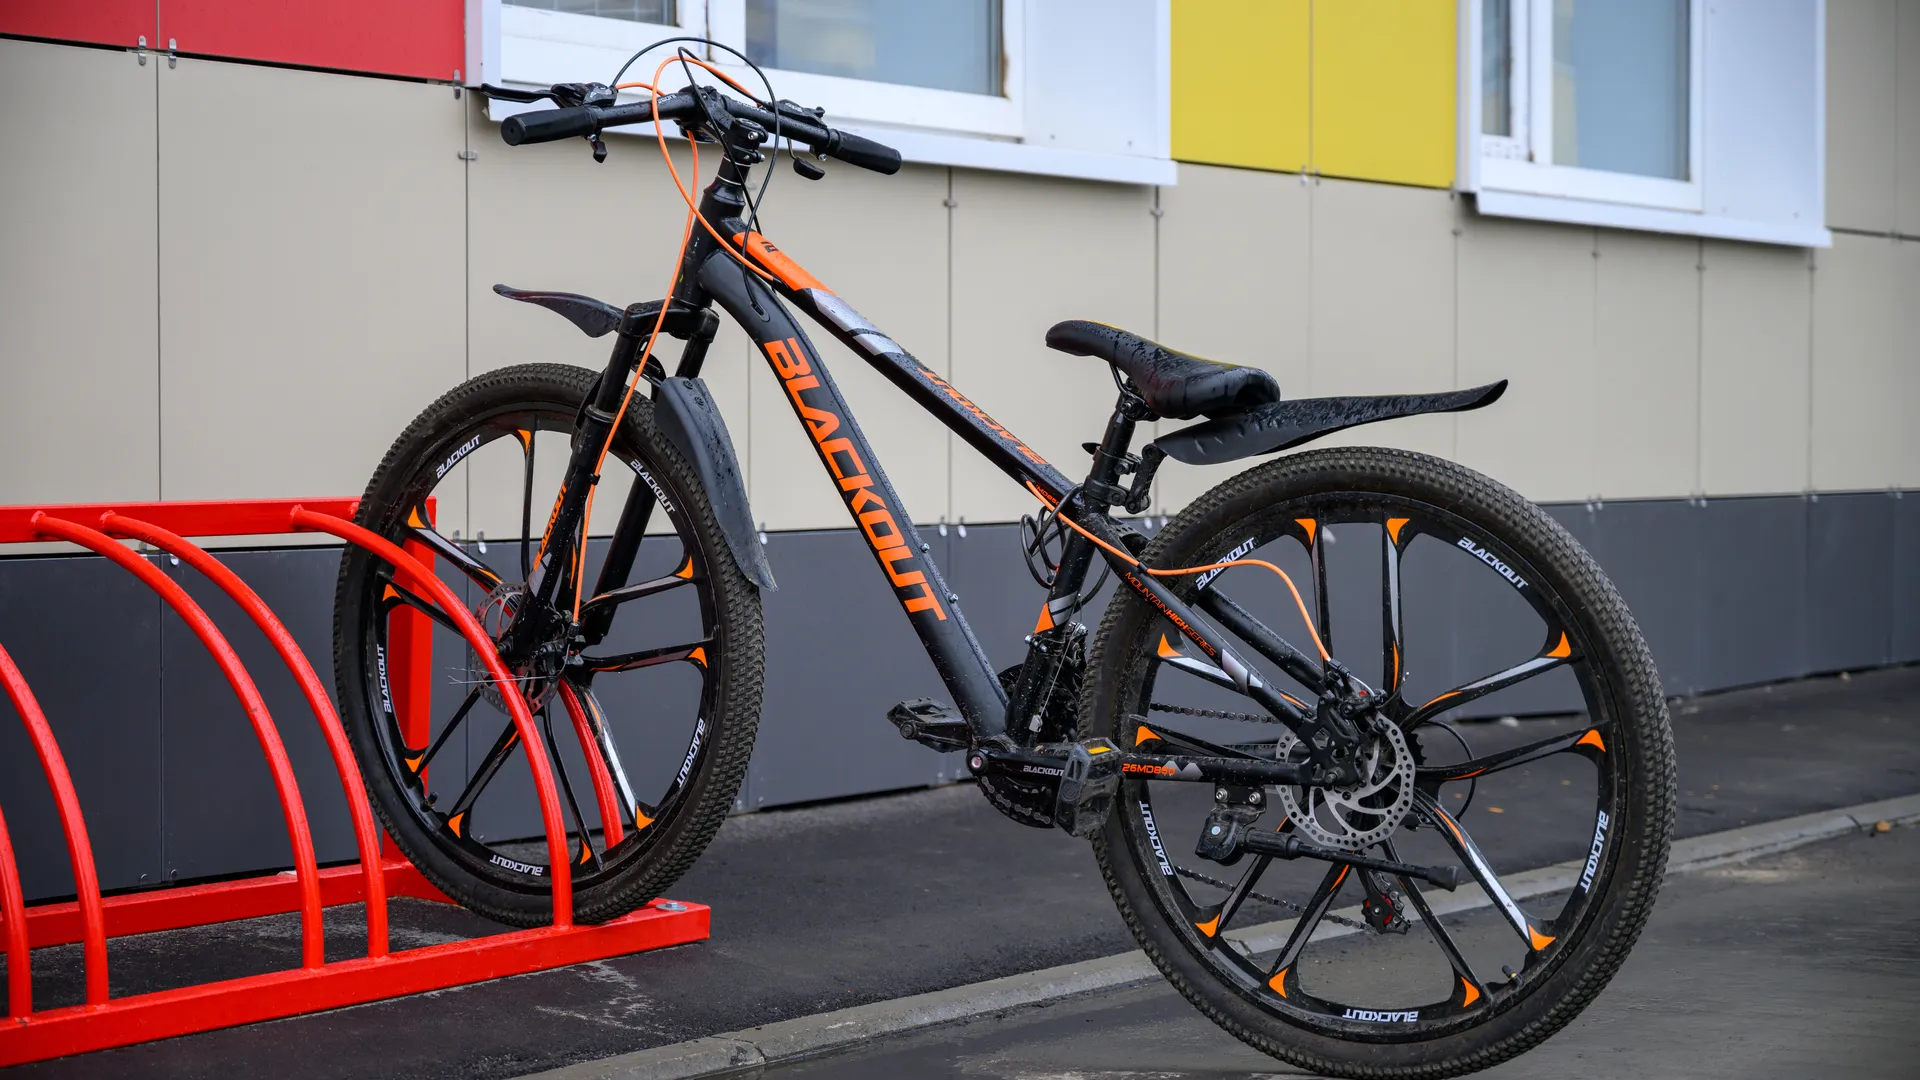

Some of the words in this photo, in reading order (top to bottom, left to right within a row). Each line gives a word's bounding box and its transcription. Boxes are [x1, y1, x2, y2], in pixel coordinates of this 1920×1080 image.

[918, 367, 1049, 465] BLACKOUT
[436, 434, 481, 479] BLACKOUT
[630, 459, 676, 514] BLACKOUT
[764, 337, 947, 621] BLACKOUT
[533, 479, 567, 571] BLACKOUT
[1457, 536, 1528, 589] BLACKOUT
[377, 644, 392, 714] BLACKOUT
[676, 717, 706, 788] BLACKOUT
[1023, 765, 1065, 777] BLACKOUT
[490, 854, 544, 877] BLACKOUT
[1139, 801, 1172, 876] BLACKOUT
[1579, 810, 1610, 893] BLACKOUT
[1342, 1008, 1418, 1023] BLACKOUT
